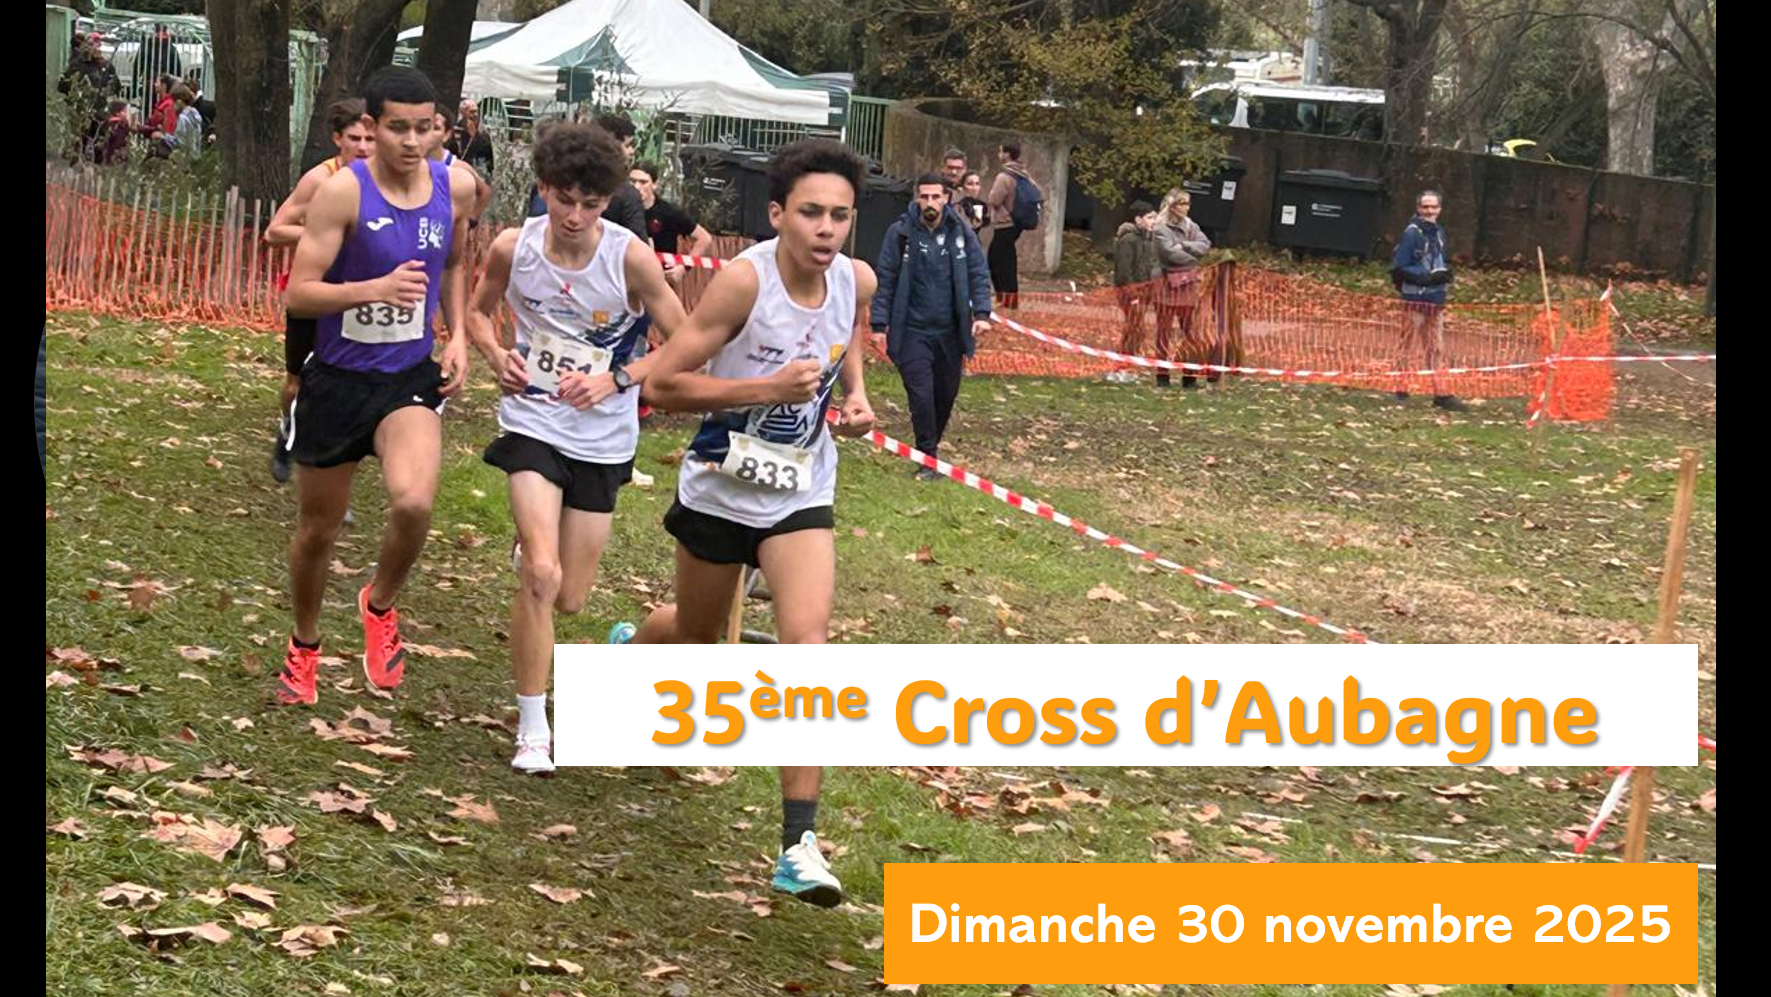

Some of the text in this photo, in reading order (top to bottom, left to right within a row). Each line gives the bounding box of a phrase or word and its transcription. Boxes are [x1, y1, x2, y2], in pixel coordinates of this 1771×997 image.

[417, 217, 429, 250] UCB
[356, 304, 413, 326] 835
[736, 457, 798, 491] 833
